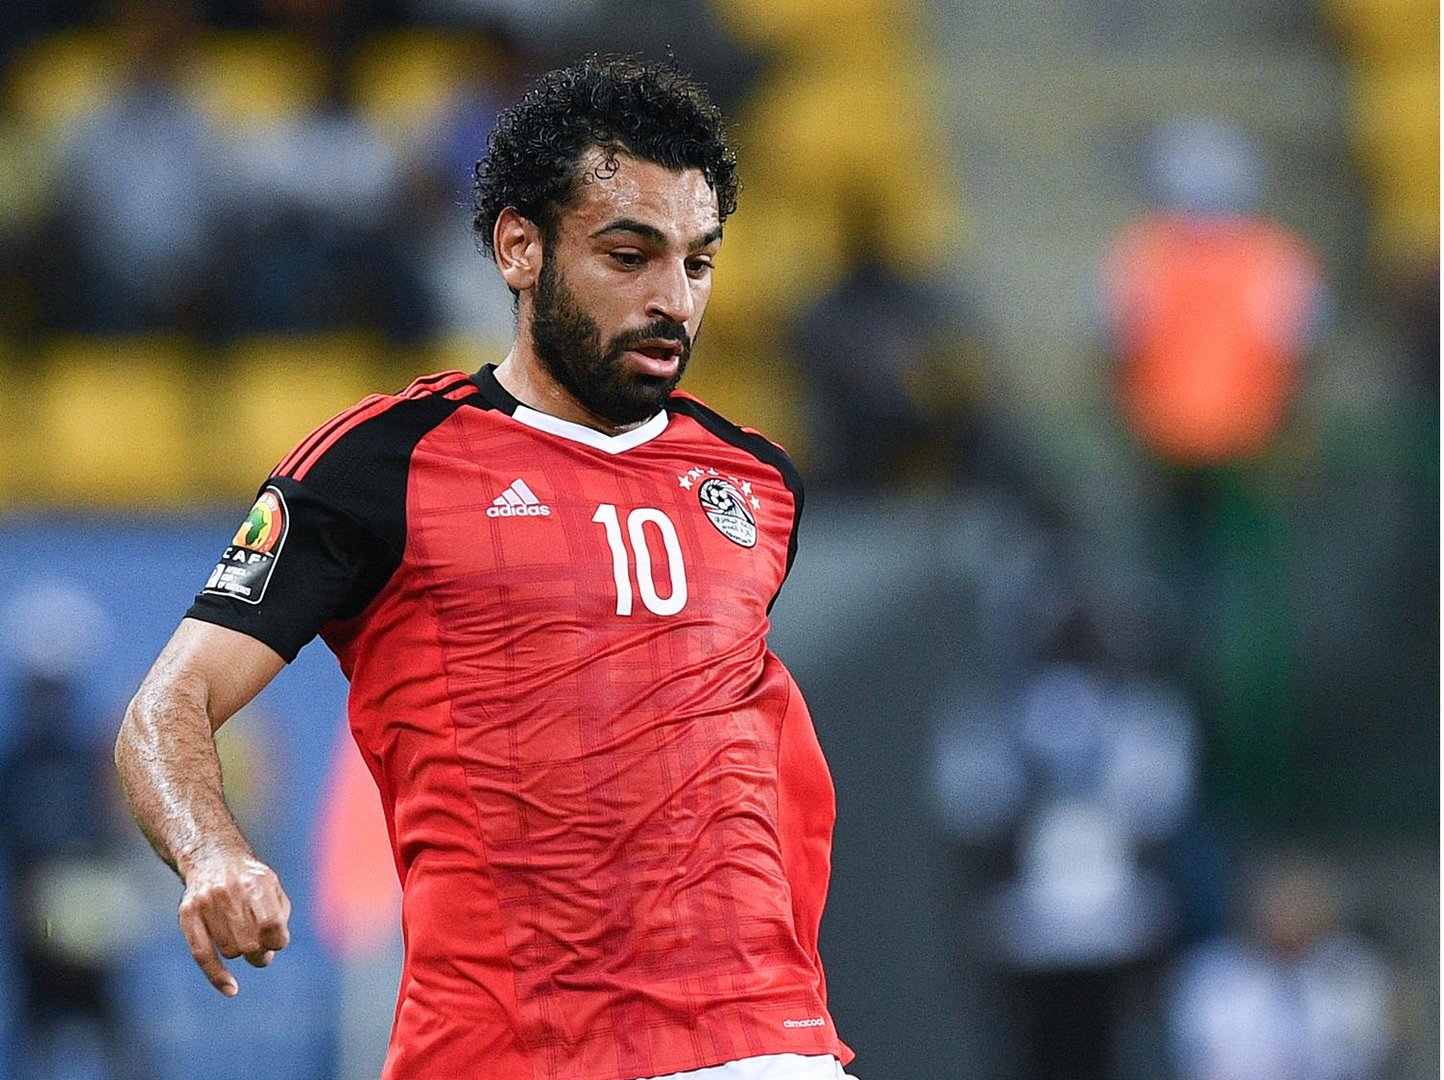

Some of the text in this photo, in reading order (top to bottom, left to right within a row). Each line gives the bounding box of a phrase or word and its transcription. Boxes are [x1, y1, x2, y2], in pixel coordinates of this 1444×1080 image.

[486, 503, 550, 517] adidas
[222, 547, 261, 564] CAF
[592, 504, 687, 616] 10
